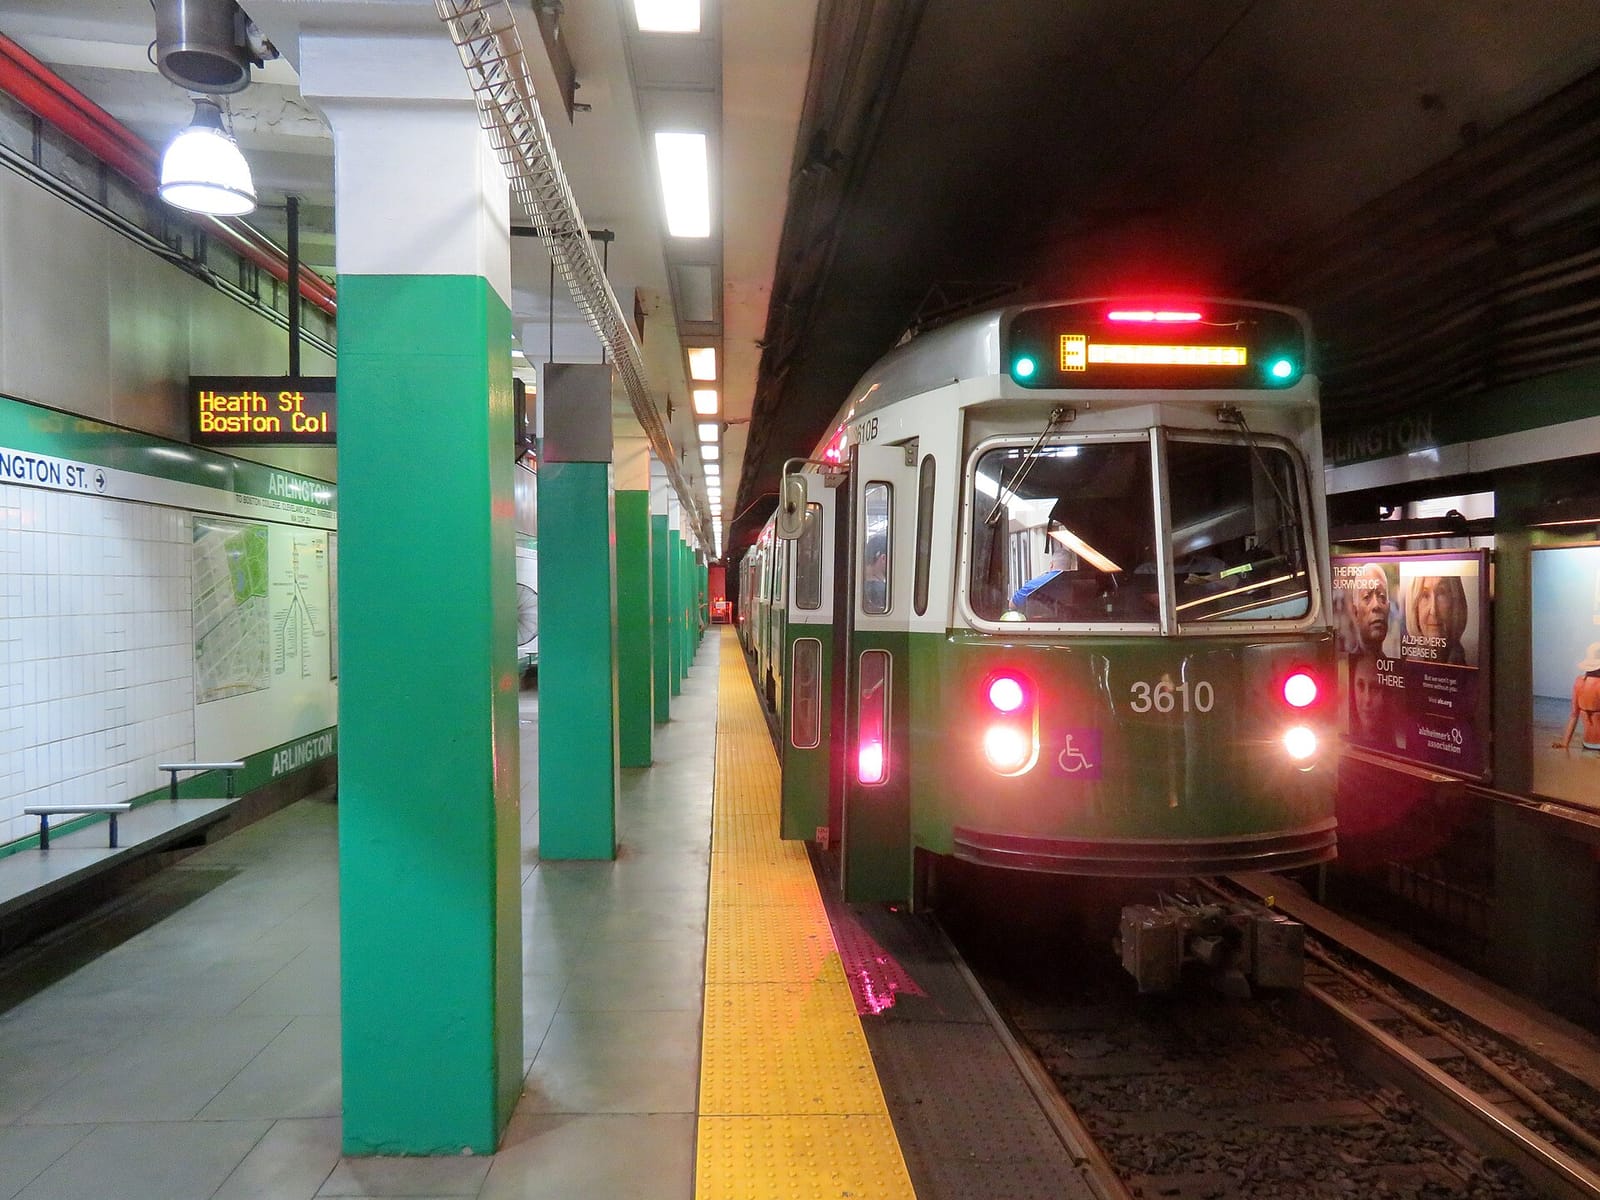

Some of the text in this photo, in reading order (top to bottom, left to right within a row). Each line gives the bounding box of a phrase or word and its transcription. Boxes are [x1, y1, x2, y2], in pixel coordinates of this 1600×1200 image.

[1062, 336, 1084, 370] E
[200, 391, 305, 412] Heath St
[200, 411, 328, 432] Boston Col
[0, 452, 88, 488] NGTON ST.
[268, 473, 329, 505] ARLINGTON
[1333, 566, 1366, 577] THE FIRST
[1333, 579, 1379, 590] SURVIVOR OF
[1401, 634, 1447, 648] ALZHEIMER'S
[1401, 645, 1438, 659] DISEASE IS
[1376, 659, 1395, 672] OUT
[1130, 681, 1214, 713] 3610
[1418, 726, 1451, 741] alzheimer's
[271, 733, 333, 777] ARLINGTON
[1427, 740, 1462, 754] association
